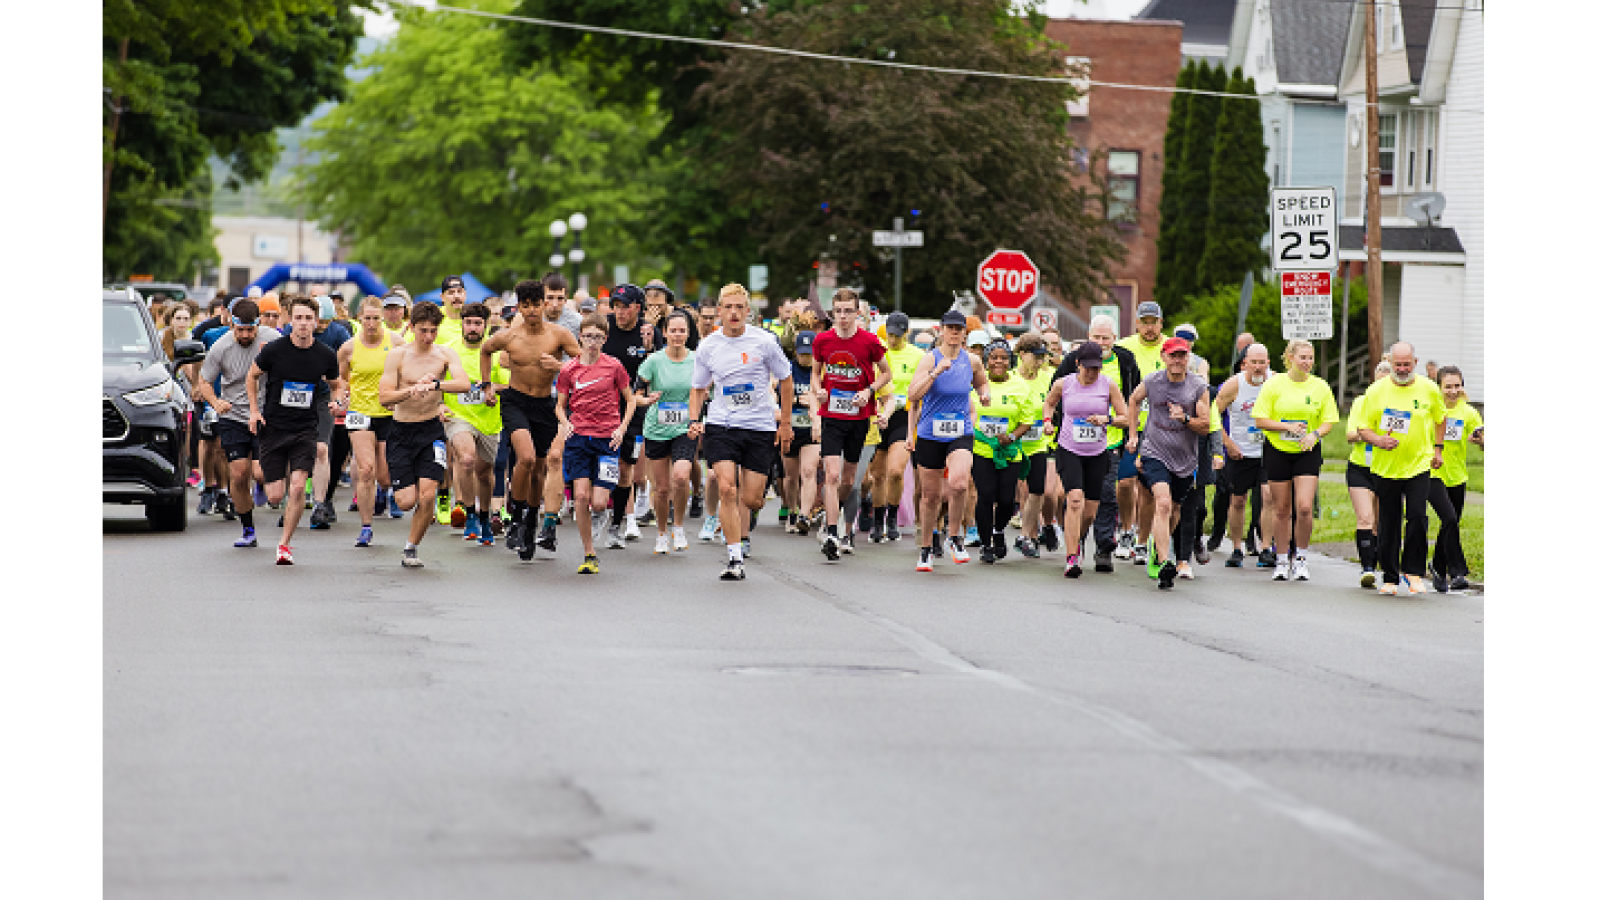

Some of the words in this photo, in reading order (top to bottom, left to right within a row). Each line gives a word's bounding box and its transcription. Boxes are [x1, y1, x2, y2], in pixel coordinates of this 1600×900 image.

[1277, 195, 1331, 211] SPEED
[1283, 213, 1325, 228] LIMIT
[1279, 230, 1331, 260] 25
[982, 267, 1034, 293] STOP
